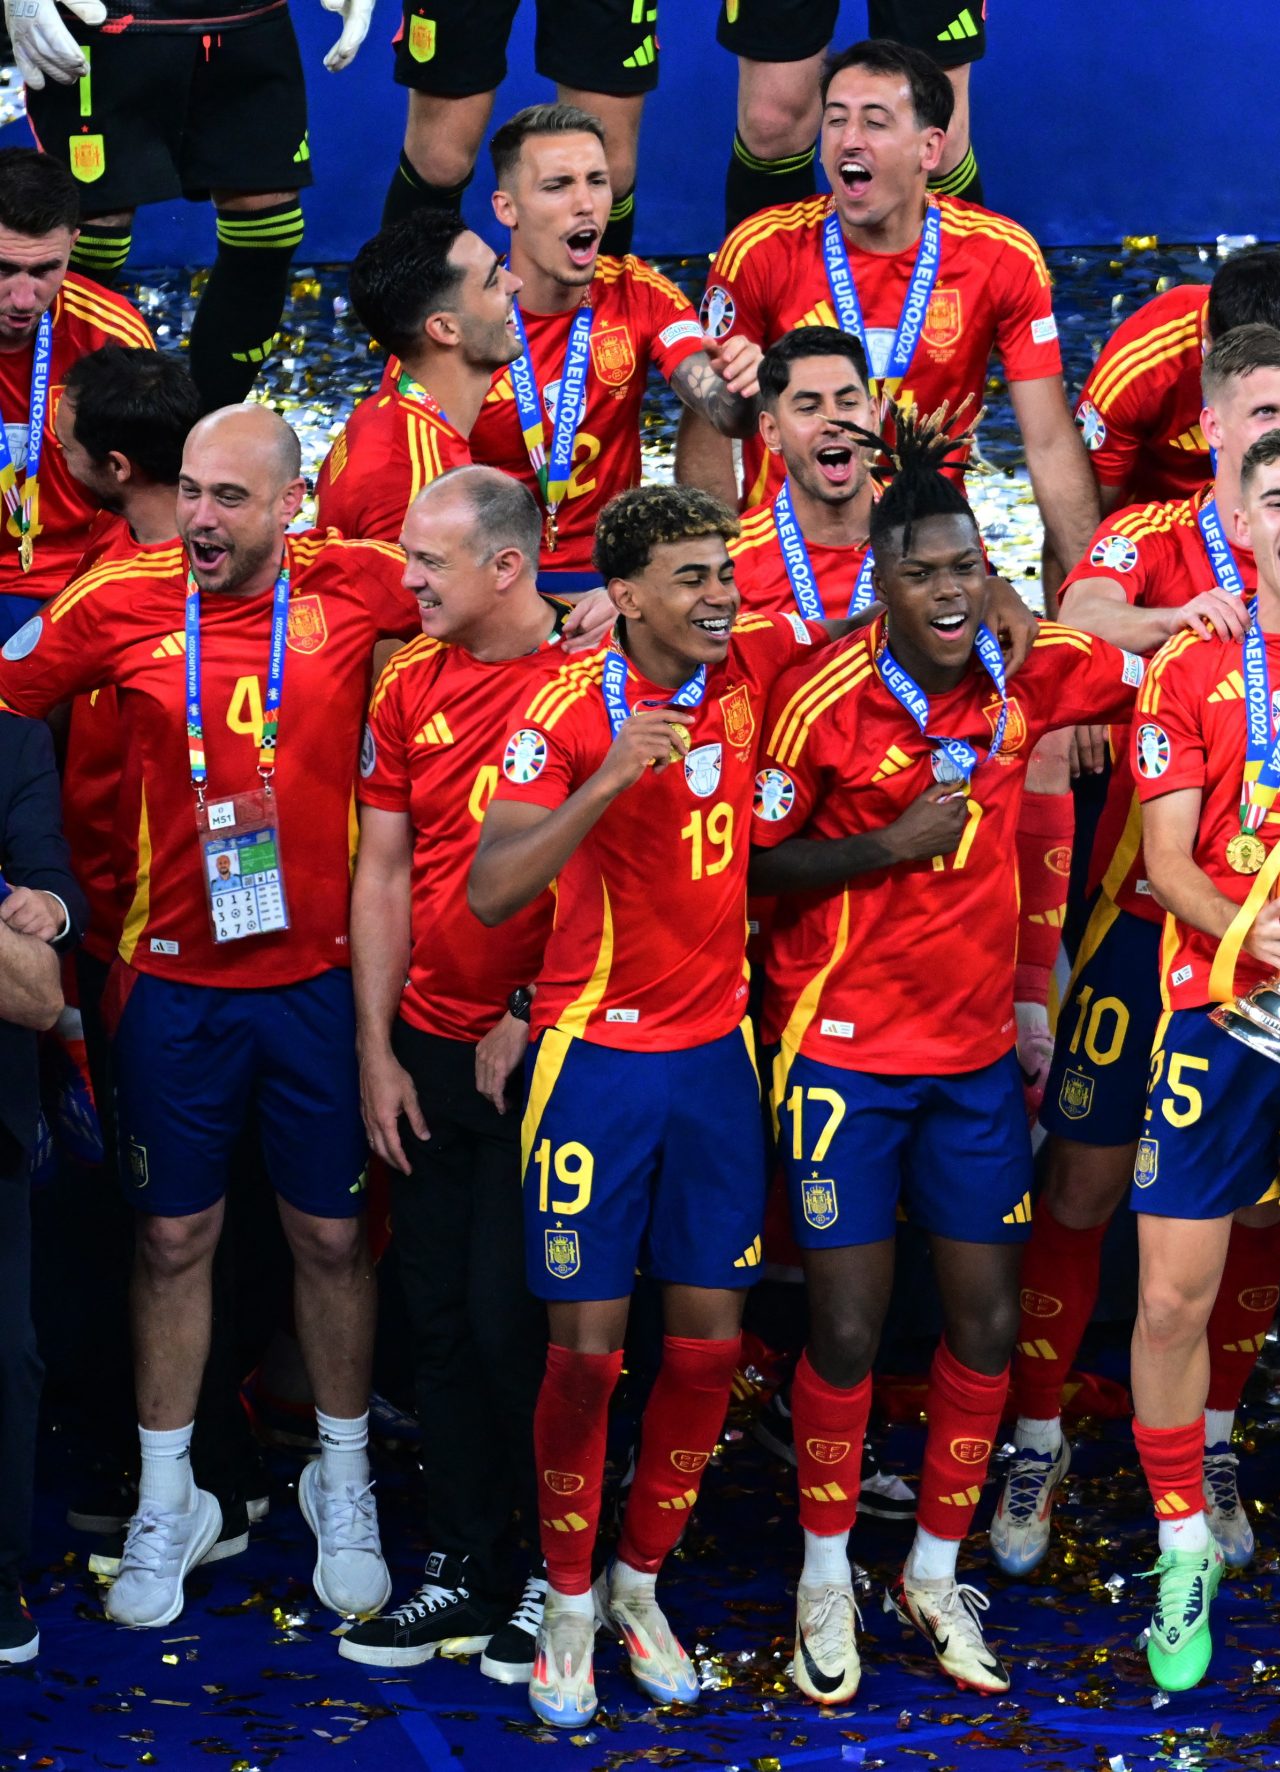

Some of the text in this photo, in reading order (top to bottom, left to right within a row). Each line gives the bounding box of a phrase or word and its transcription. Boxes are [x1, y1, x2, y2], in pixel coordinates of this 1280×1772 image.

[226, 675, 265, 748] 4
[681, 802, 734, 880] 19
[216, 890, 252, 908] 0 1 2
[218, 905, 254, 923] 3 5
[220, 923, 241, 938] 6 7
[1069, 985, 1130, 1066] 10
[786, 1085, 846, 1161] 17
[534, 1138, 594, 1215] 19
